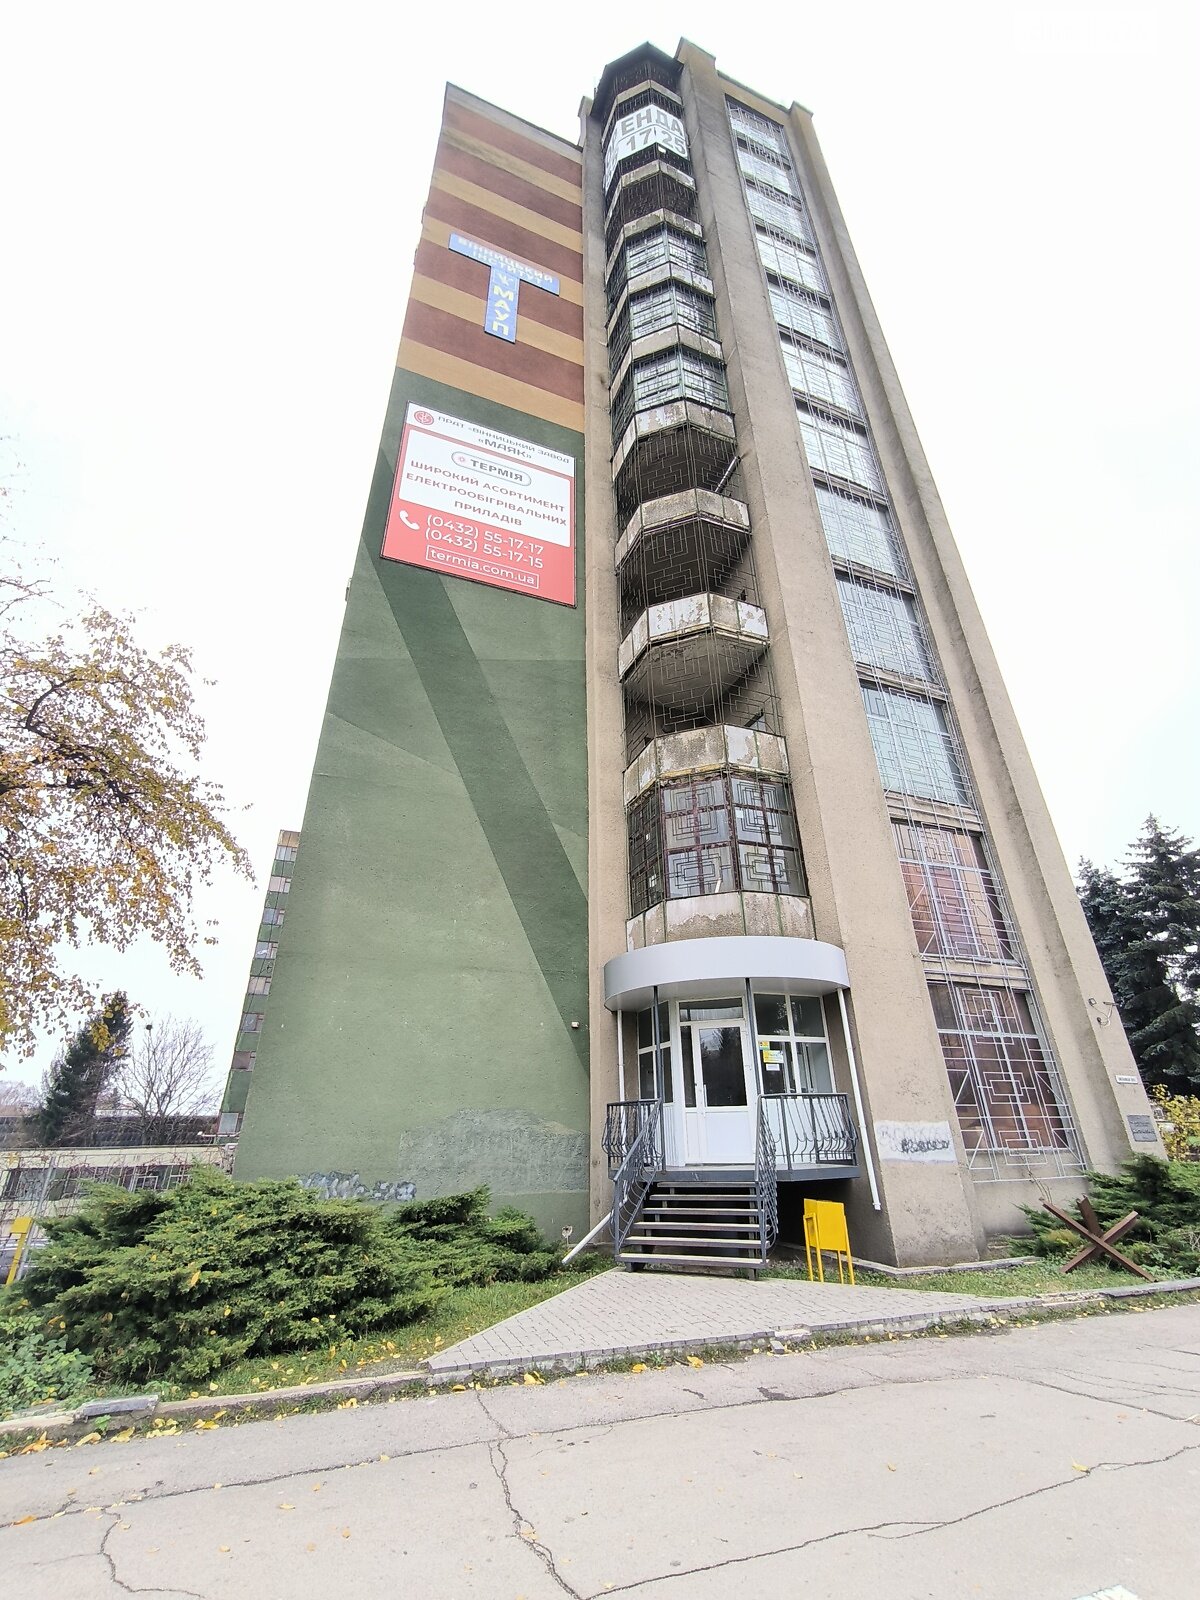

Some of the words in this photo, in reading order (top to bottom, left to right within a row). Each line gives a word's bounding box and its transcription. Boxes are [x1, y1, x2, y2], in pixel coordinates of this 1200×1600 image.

[478, 438, 532, 459] «МАЯК»
[537, 449, 570, 464] ЗАВОД
[410, 460, 479, 486] ШИРОКИЙ
[482, 482, 565, 512] АСОРТИМЕНТ
[470, 458, 523, 482] ТЕРМІЯ
[406, 472, 567, 526] ЕЛЕКТРООБІГРІВАЛЬНИХ
[454, 500, 522, 526] ПРИЛАДІВ
[425, 527, 478, 553] (0432)
[483, 543, 543, 569] 55-17-15
[427, 514, 479, 540] (0432)
[484, 530, 544, 555] 55-17-17
[430, 549, 535, 585] termia.com.ua
